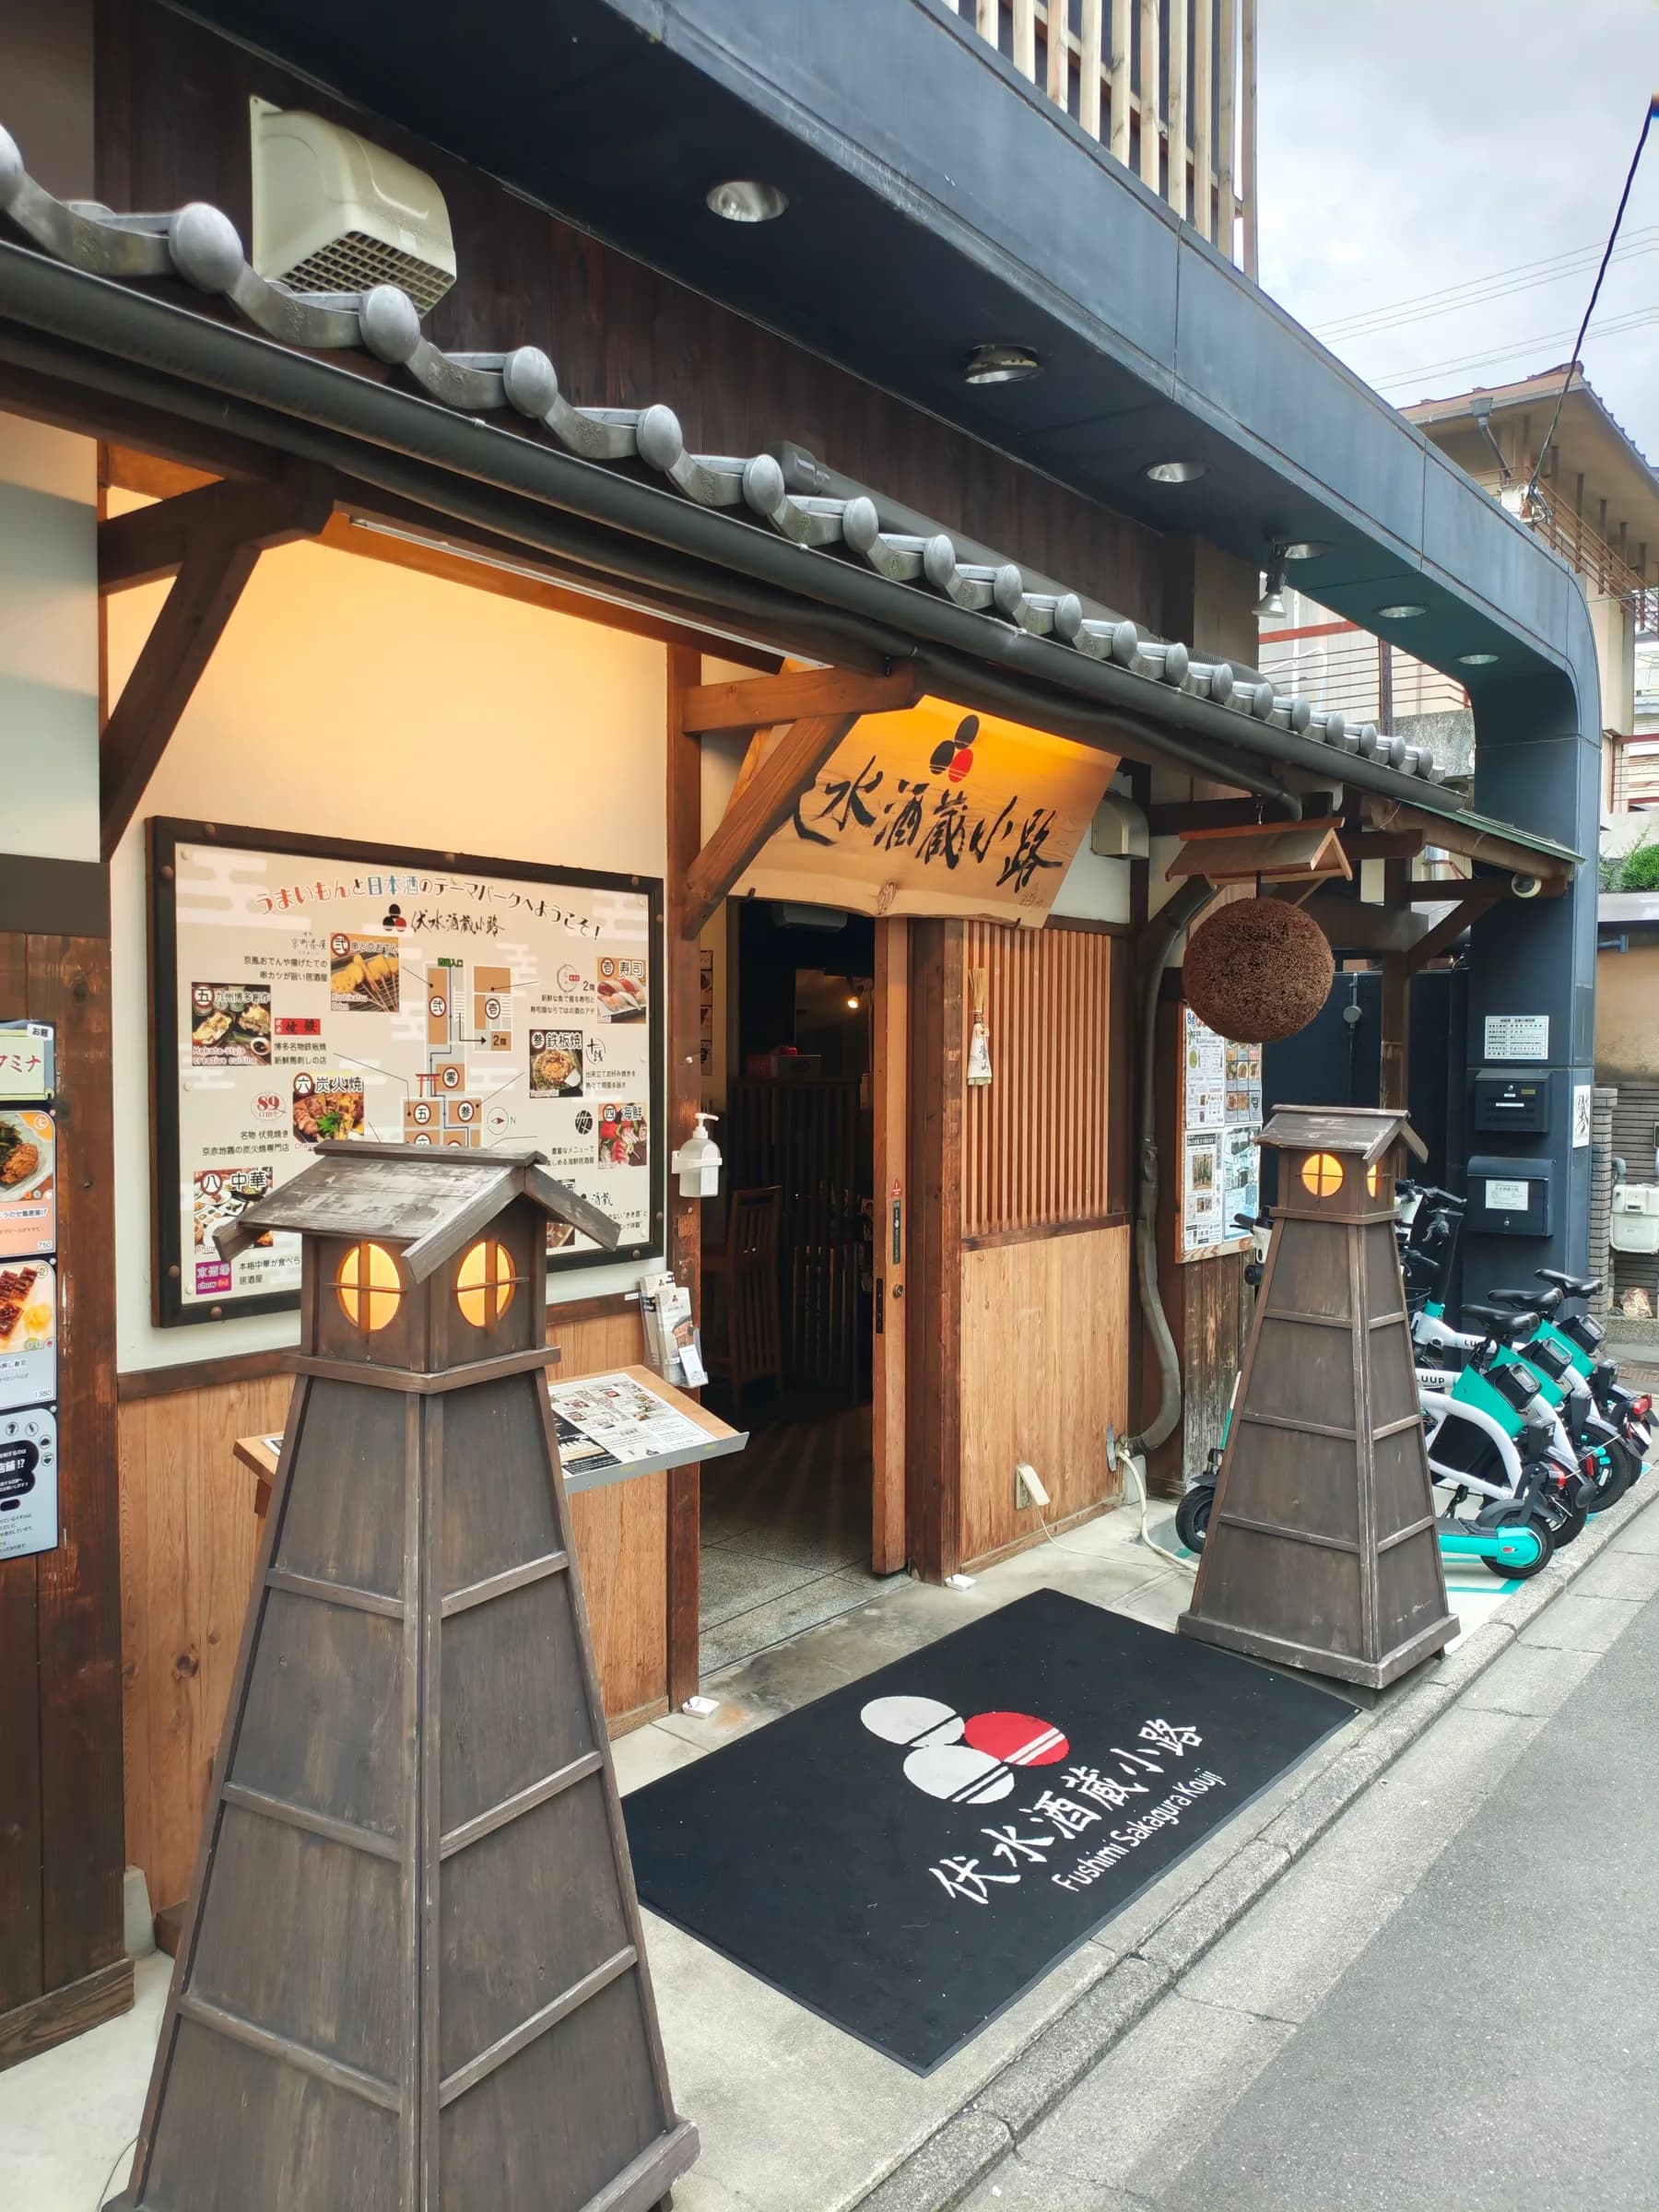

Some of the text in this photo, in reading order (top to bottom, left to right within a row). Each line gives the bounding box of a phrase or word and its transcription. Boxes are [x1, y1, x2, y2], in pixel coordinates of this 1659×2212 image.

[793, 755, 1063, 892] 水酒蔵小路
[411, 910, 506, 937] 伏水酒蔵小路
[618, 960, 643, 977] 寿司
[547, 1032, 582, 1050] 鉄板焼
[315, 1077, 362, 1092] 炭火焼
[622, 1106, 642, 1121] 海鮮
[231, 1171, 266, 1190] 中華
[928, 1718, 1203, 1904] 伏水酒蔵小路
[1051, 1767, 1228, 1892] Fushimi Sakagura Kouji
